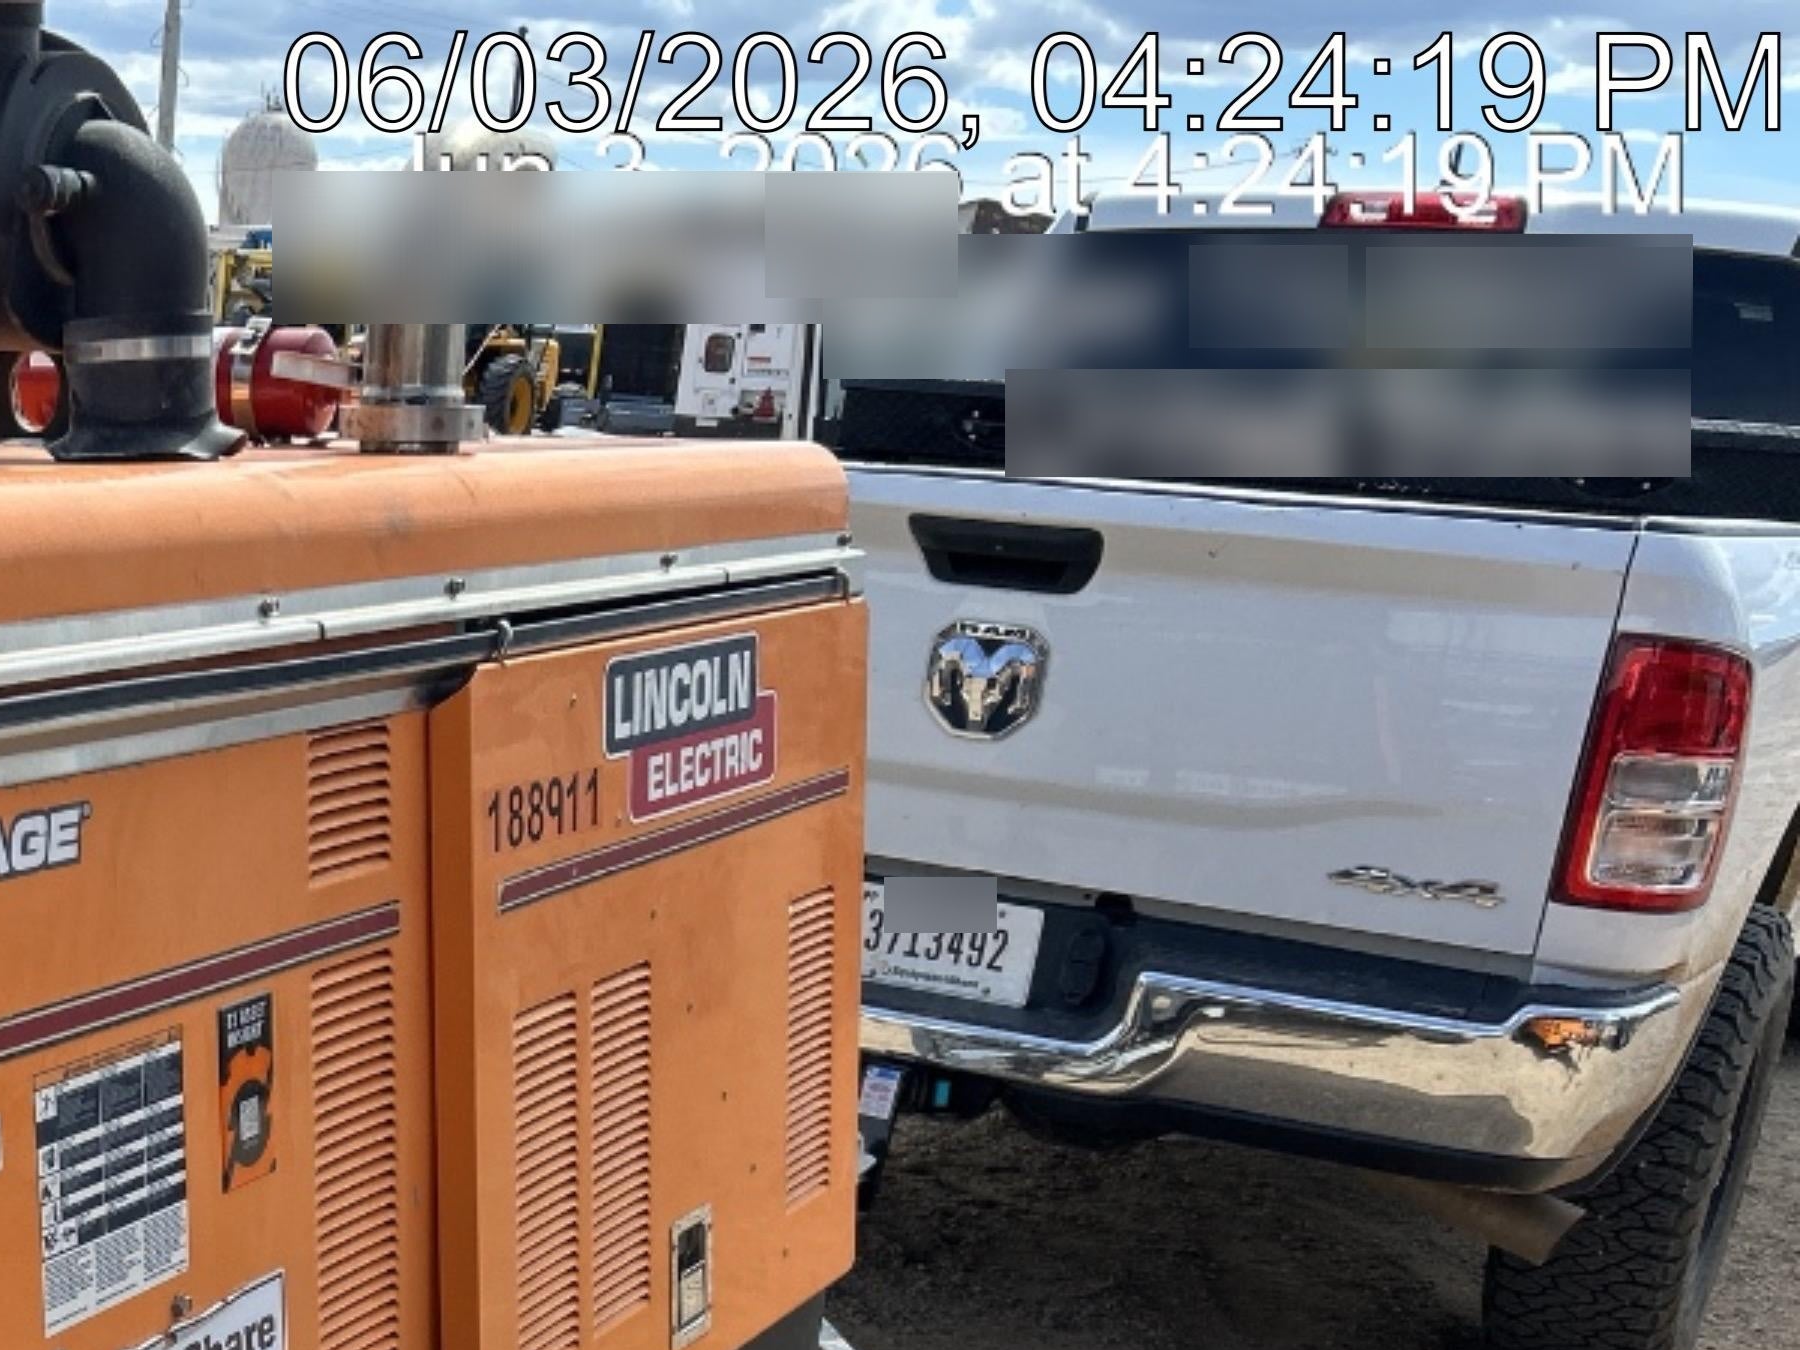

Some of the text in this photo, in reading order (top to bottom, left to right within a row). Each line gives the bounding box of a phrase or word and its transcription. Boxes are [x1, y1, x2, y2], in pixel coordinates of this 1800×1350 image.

[613, 650, 751, 741] LINCOLN
[646, 727, 764, 803] ELECTRIC
[487, 767, 599, 853] 188911
